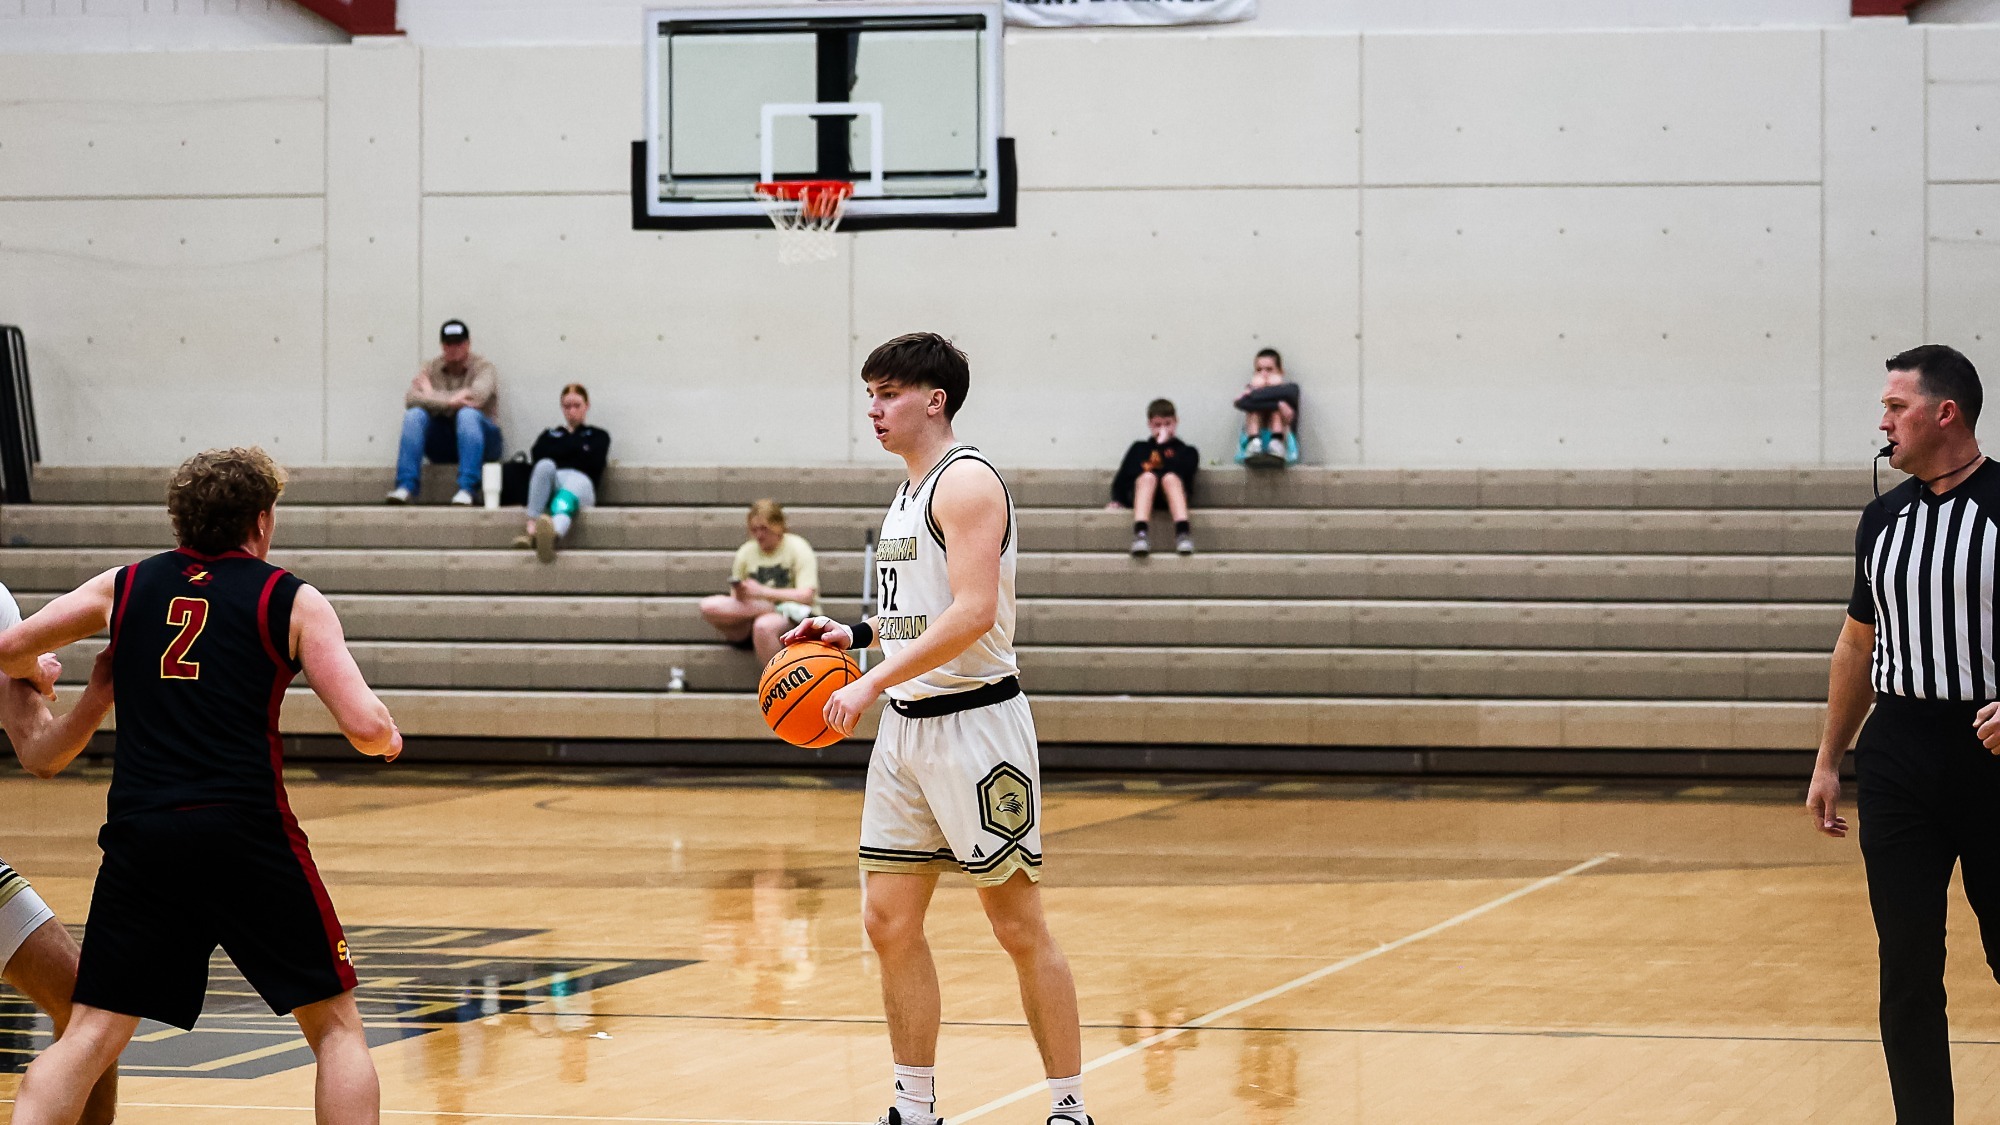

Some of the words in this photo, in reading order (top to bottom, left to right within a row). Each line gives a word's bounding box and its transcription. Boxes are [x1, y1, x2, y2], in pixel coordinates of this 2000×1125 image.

[880, 567, 898, 611] 32
[161, 596, 209, 680] 2
[761, 665, 814, 716] Wilson
